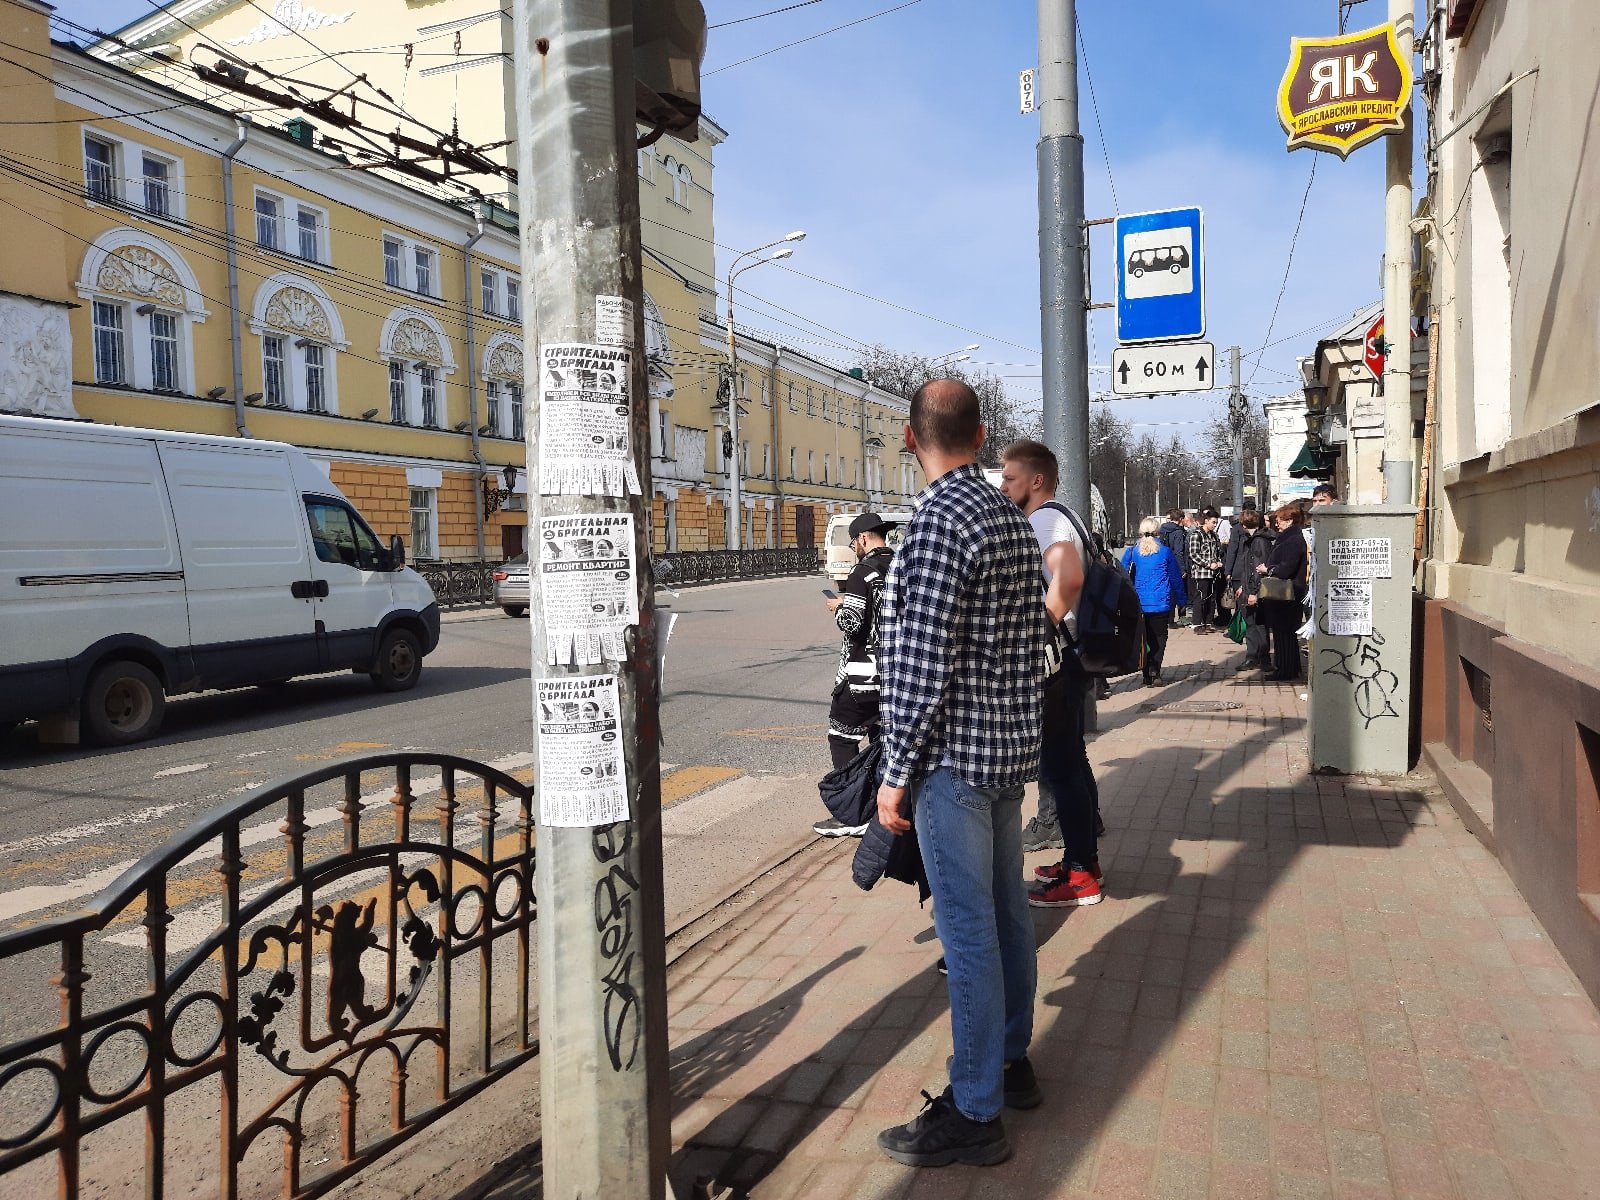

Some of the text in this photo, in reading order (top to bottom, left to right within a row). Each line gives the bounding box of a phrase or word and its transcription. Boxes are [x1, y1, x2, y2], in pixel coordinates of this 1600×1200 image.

[1308, 51, 1378, 103] ЯК
[1022, 73, 1032, 109] 0075
[1298, 103, 1393, 129] ЯРОСЛАВСКИЙ КРЕДИТ
[1334, 121, 1357, 133] 1997
[544, 347, 630, 363] СТРОИТЕЛЬНАЯ
[559, 358, 615, 371] БРИГАДА
[1143, 361, 1167, 377] 60
[542, 517, 628, 529] СТРОИТЕЛЬНАЯ
[557, 527, 610, 537] БРИГАДА
[546, 560, 626, 571] РЕМОНТ КВАРТИР
[547, 689, 595, 700] БРИГАДА
